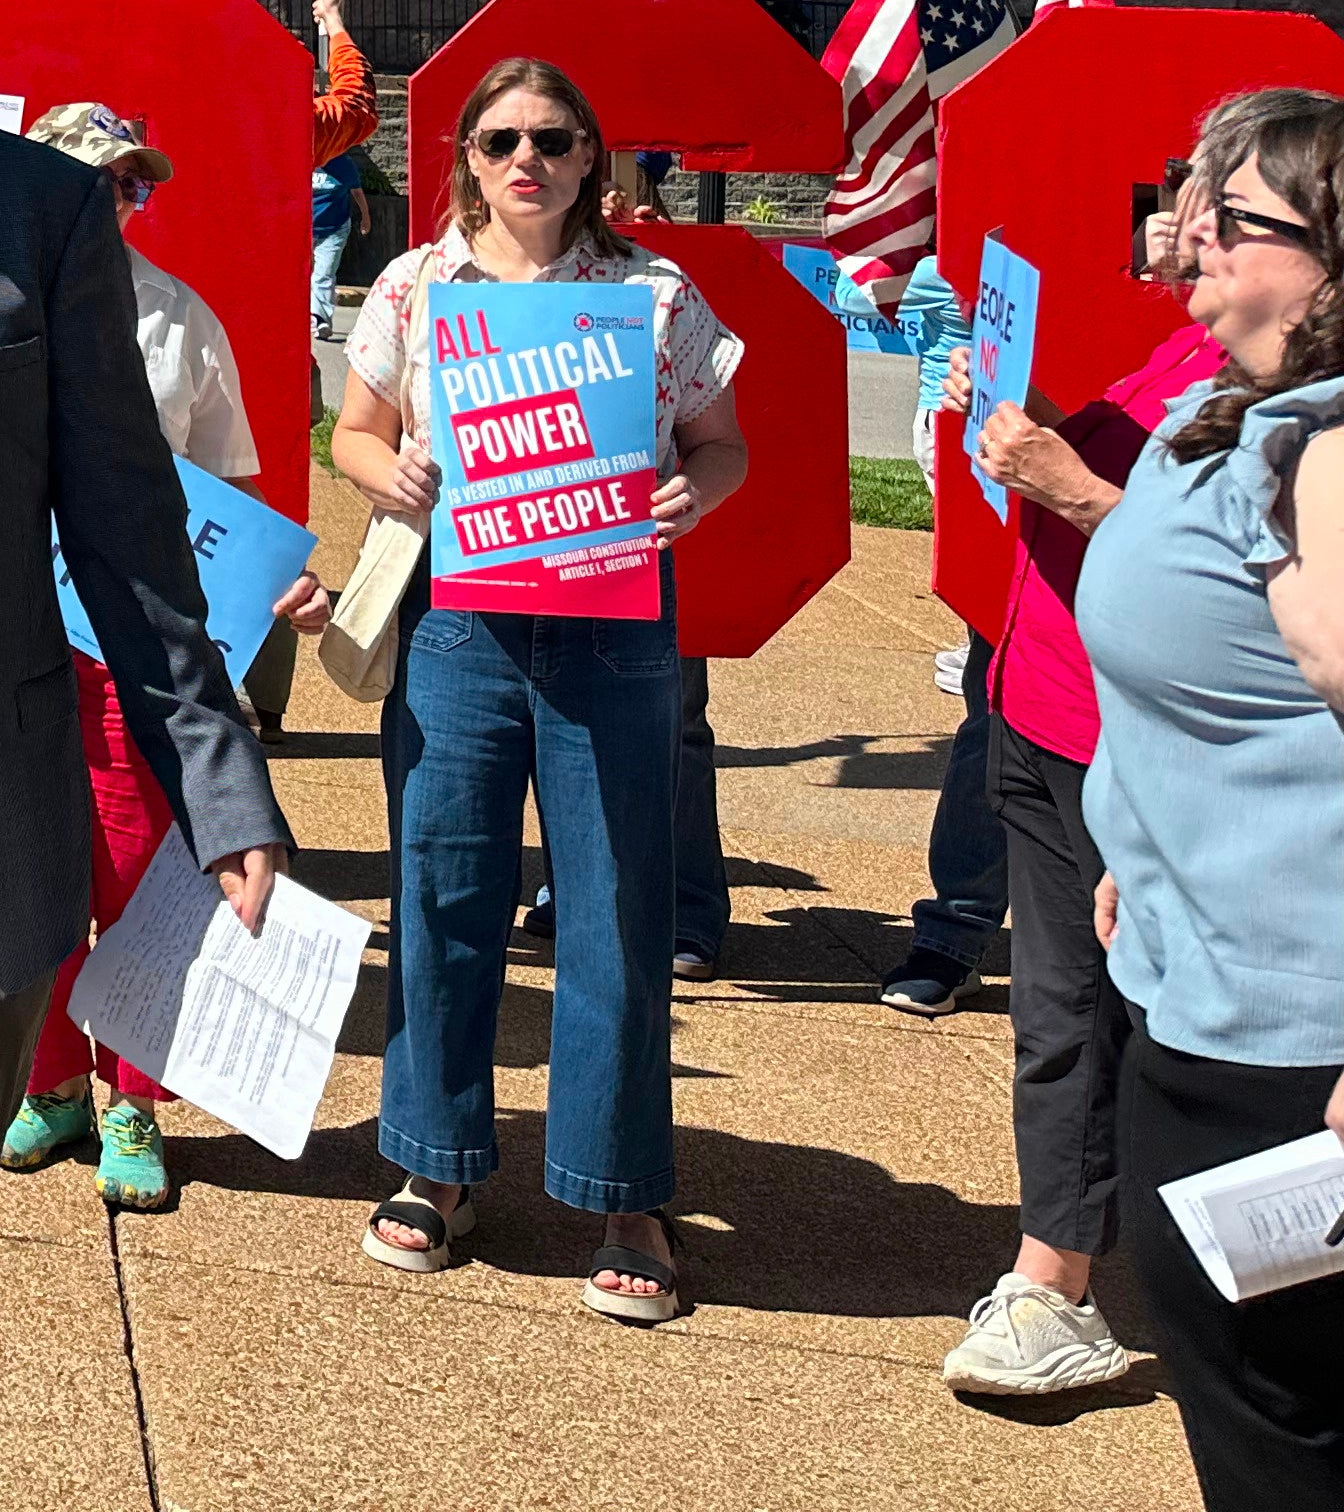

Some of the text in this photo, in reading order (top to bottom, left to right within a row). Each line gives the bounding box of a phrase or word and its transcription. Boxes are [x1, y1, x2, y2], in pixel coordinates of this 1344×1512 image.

[434, 308, 502, 365] ALL
[834, 312, 919, 338] TICIANS
[440, 332, 634, 415] POLITICAL
[979, 335, 999, 384] NO
[456, 402, 589, 469] POWER
[448, 450, 650, 506] IS VESTED IN AND DERIVED FROM
[458, 481, 632, 552] THE PEOPLE
[541, 536, 658, 569] MISSOURI CONSTITUTION,
[558, 563, 597, 582] ARTICLE
[604, 555, 643, 573] SECTION
[642, 553, 650, 565] 1
